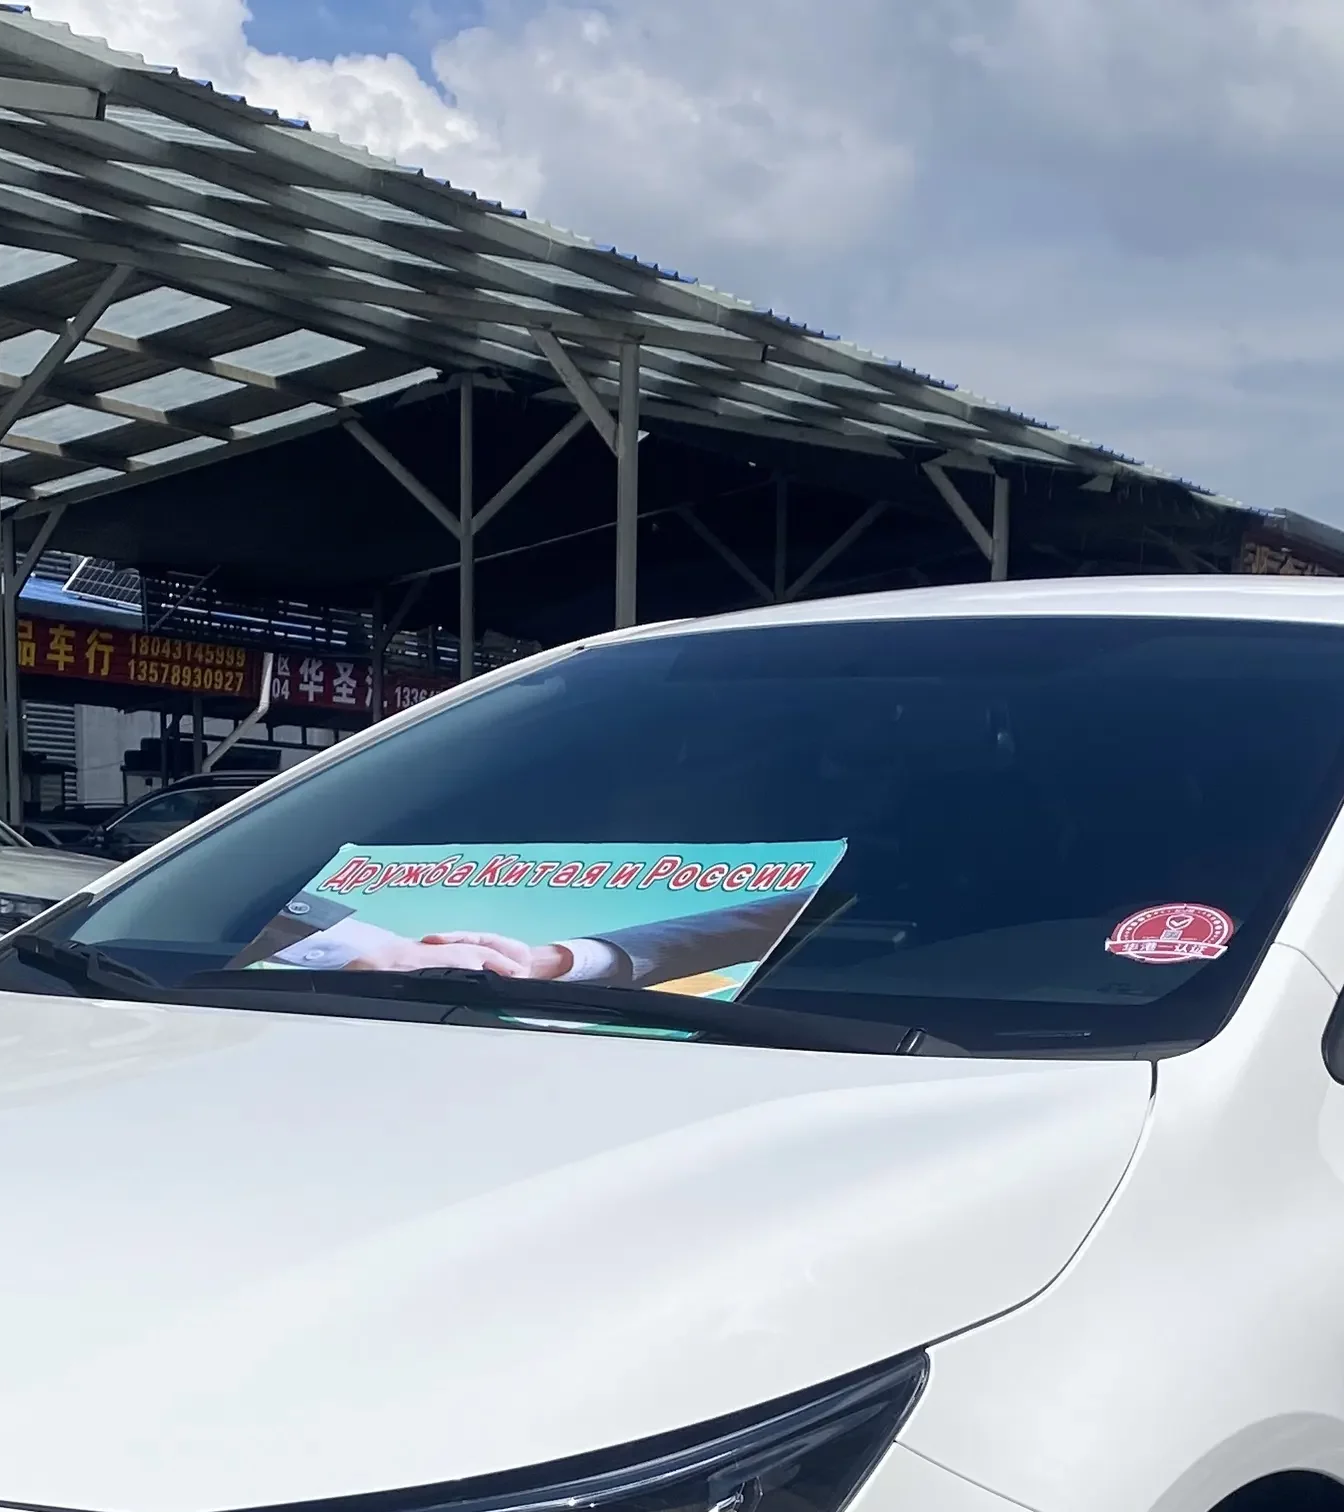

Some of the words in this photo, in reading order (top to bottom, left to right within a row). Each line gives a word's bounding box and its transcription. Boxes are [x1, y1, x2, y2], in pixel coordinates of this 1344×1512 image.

[130, 633, 246, 667] 18043145999
[128, 659, 244, 692] 13578930927
[272, 678, 290, 700] 04
[317, 854, 478, 894] Дружба
[470, 854, 612, 888] Китая
[606, 862, 646, 889] и
[637, 855, 816, 892] России
